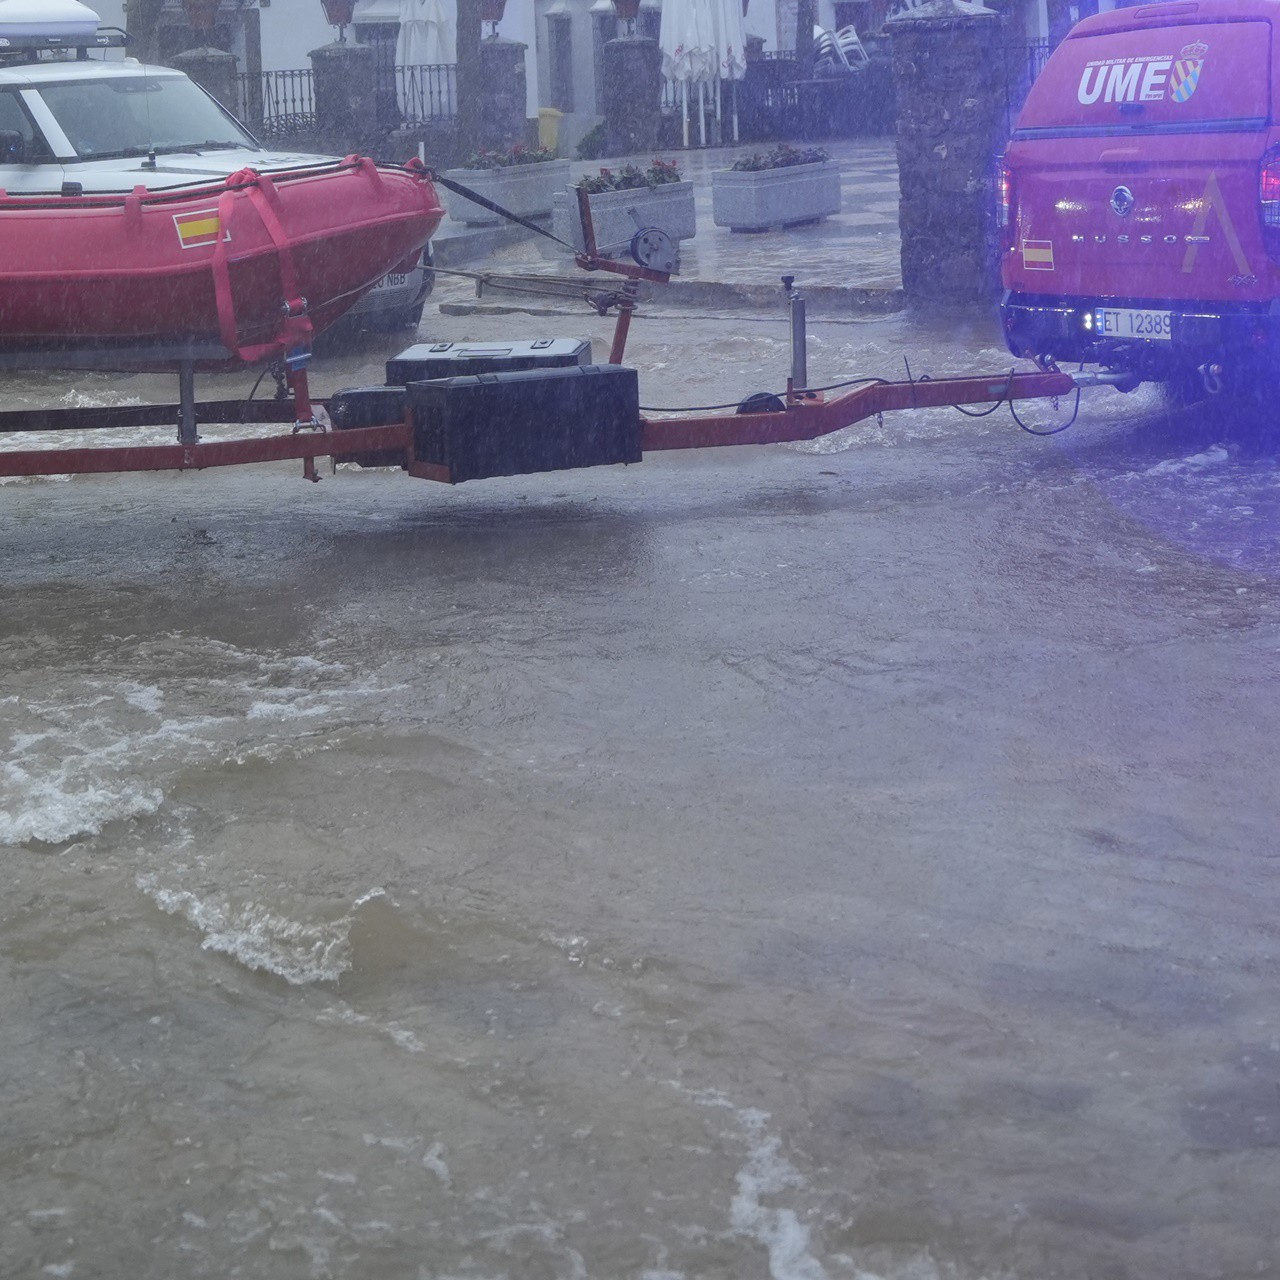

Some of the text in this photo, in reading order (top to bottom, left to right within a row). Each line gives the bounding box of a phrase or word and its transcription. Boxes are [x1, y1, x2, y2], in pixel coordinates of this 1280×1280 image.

[1077, 61, 1172, 105] UME
[1072, 234, 1177, 244] MUSSO
[1103, 311, 1172, 335] ET 12389
